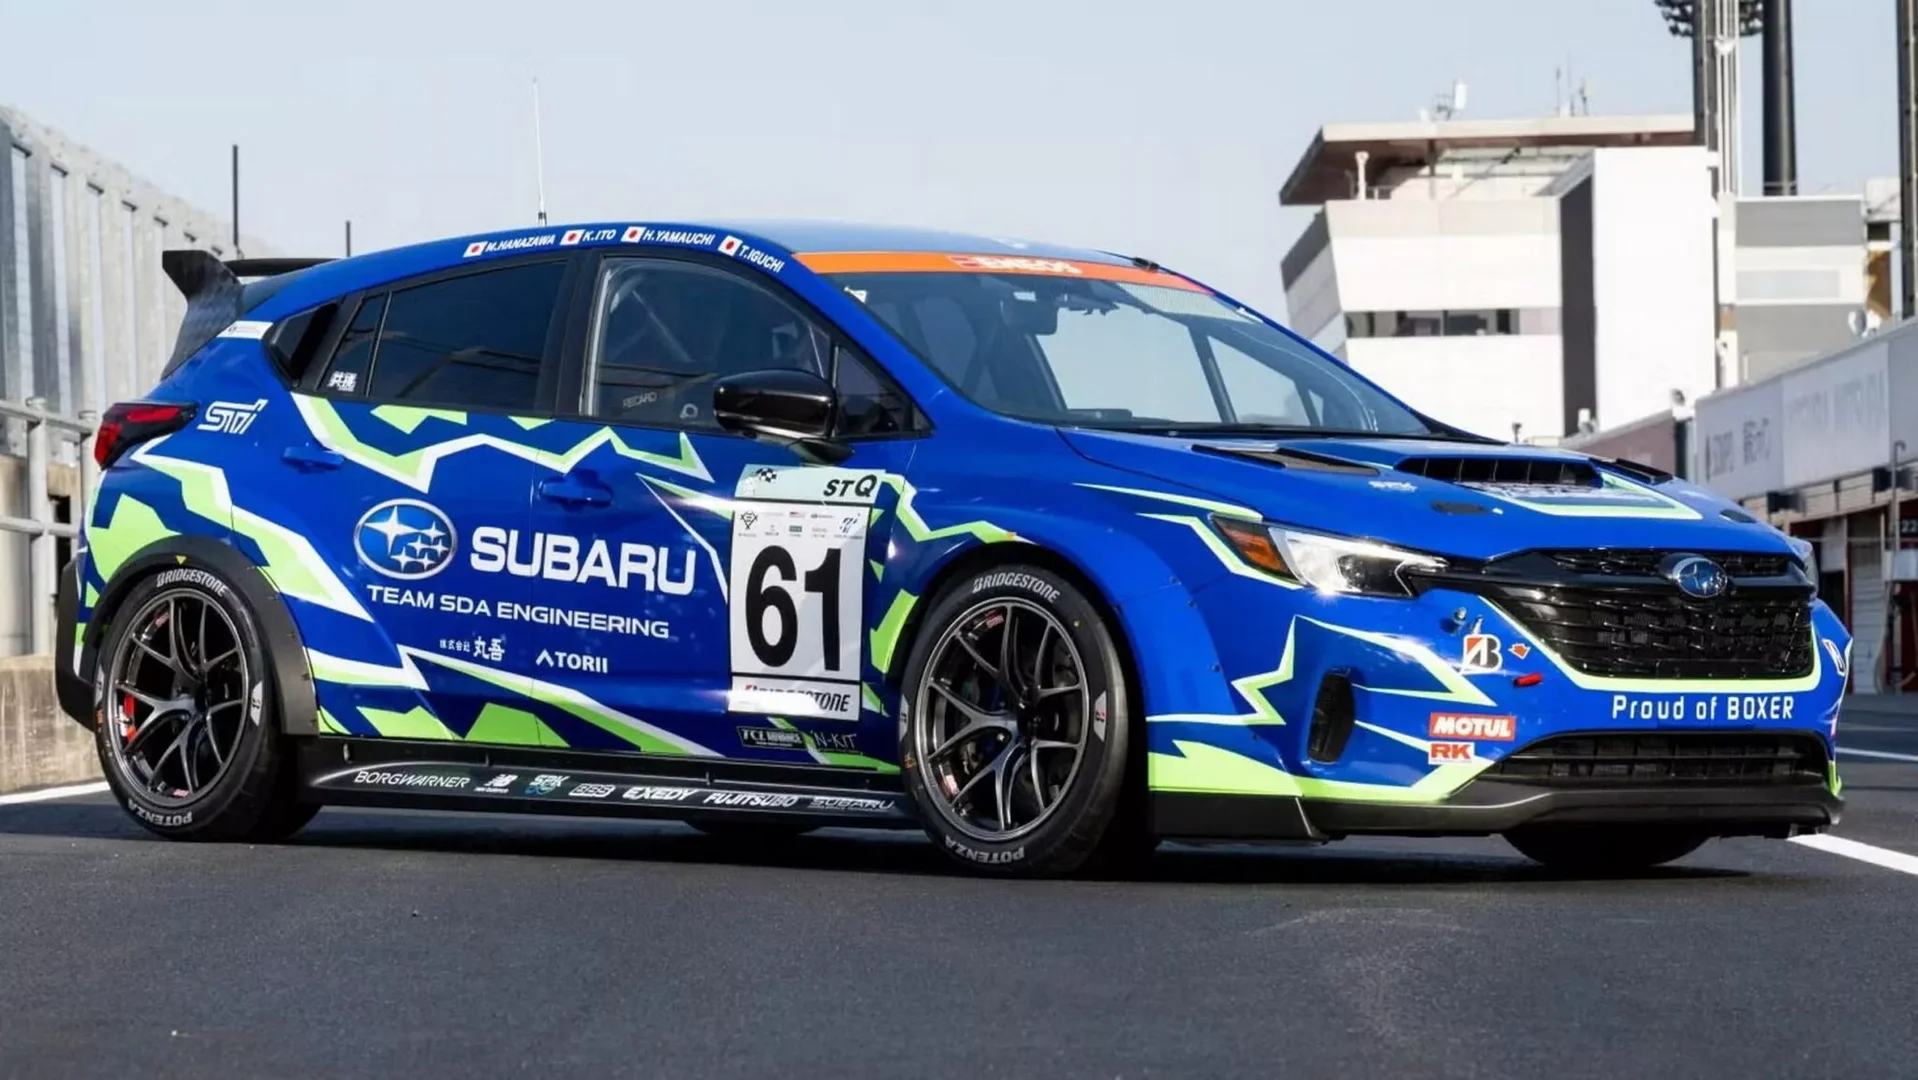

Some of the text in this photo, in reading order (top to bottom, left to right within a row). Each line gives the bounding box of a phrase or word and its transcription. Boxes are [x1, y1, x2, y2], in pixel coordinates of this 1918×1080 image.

[582, 229, 617, 242] K.ITO
[642, 229, 716, 246] H.YAMAUCHI
[738, 244, 786, 273] T.IGUCHI
[470, 526, 697, 596] SUBARU
[156, 567, 229, 598] BRIDGESTONE
[971, 571, 1061, 604] BRIDGESTONE
[366, 584, 670, 639] TEAM SDA ENGINEERING
[745, 545, 842, 672] 61
[1612, 694, 1794, 720] Proud of BOXER
[1433, 716, 1511, 737] MOTUL
[1430, 743, 1471, 759] RK
[354, 770, 471, 789] BORGWARNER
[622, 786, 699, 800] EXEDY
[703, 790, 800, 808] FUJITSUBO
[812, 796, 896, 810] SUBARU
[127, 798, 193, 827] POTENZA
[944, 835, 1025, 864] POTENZA
